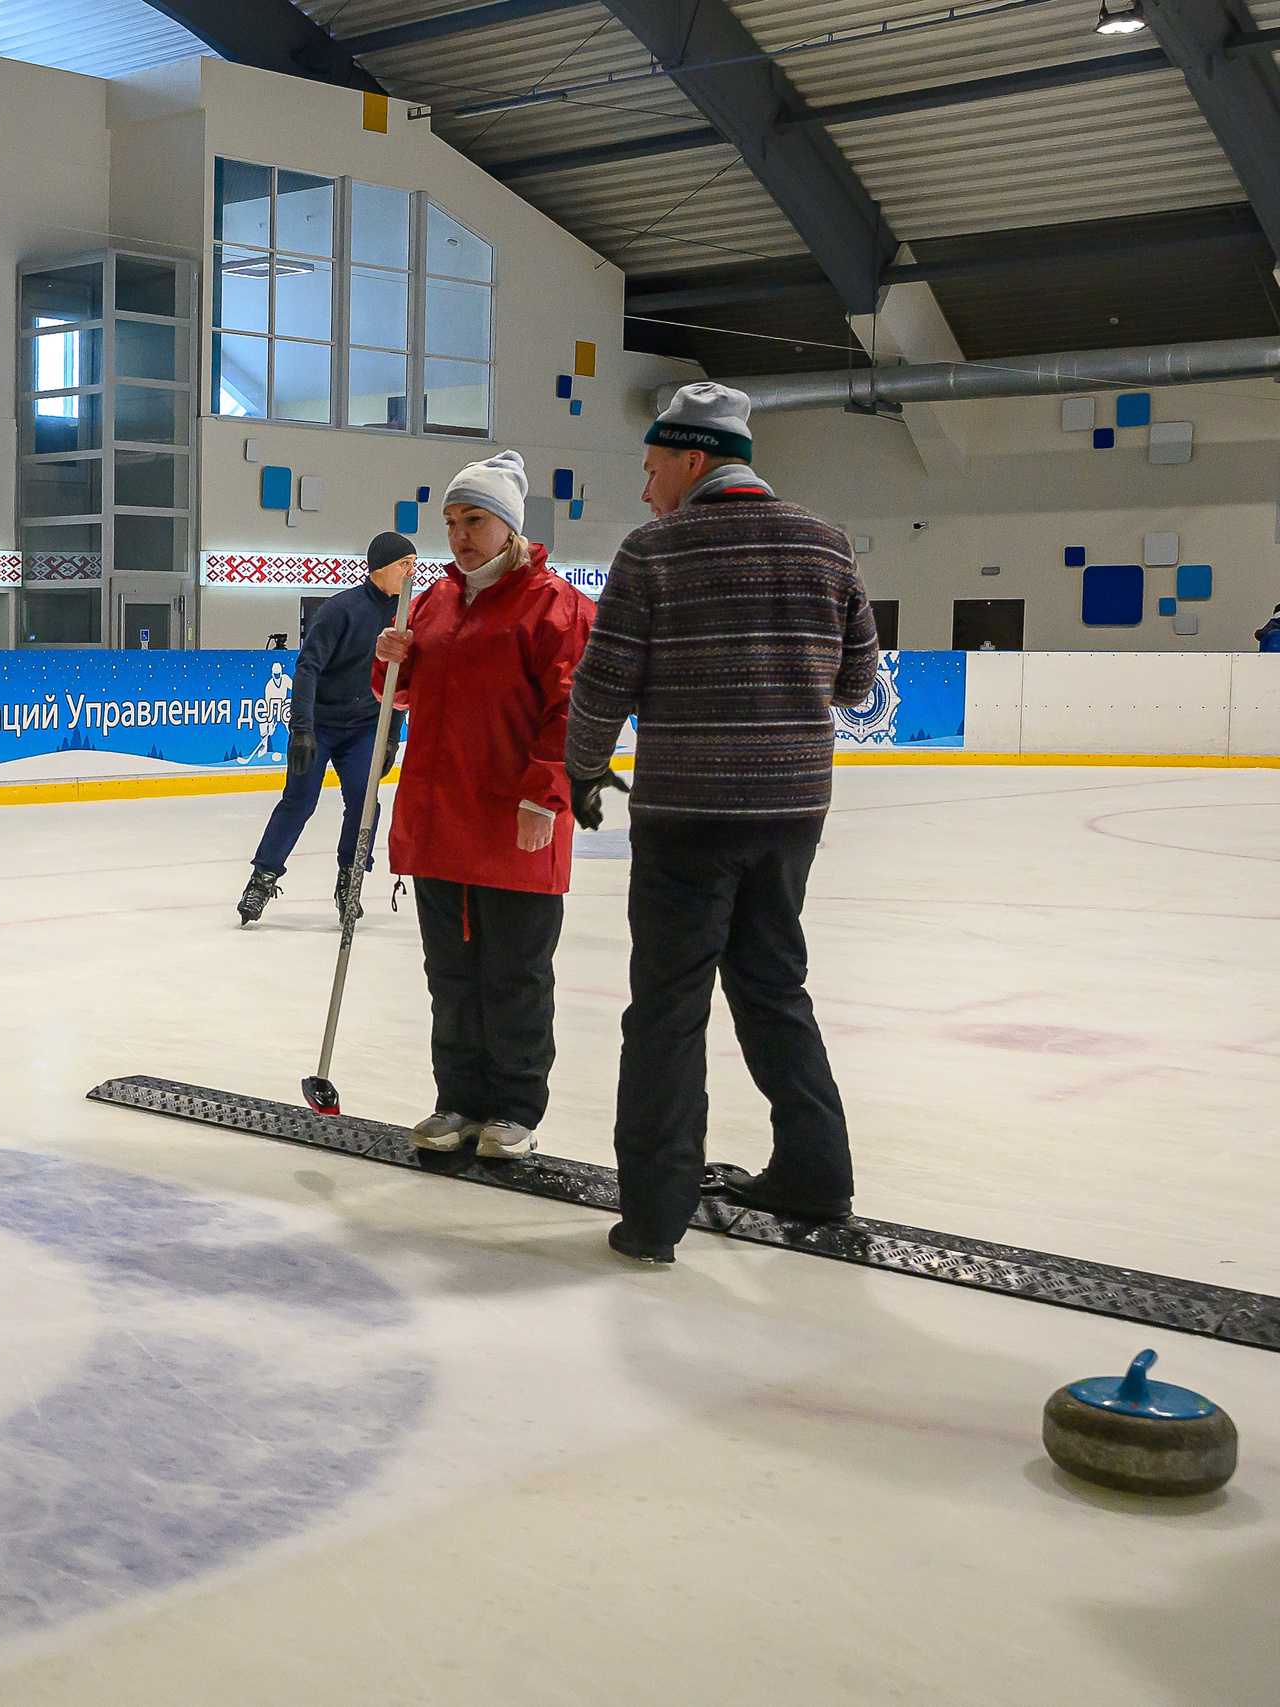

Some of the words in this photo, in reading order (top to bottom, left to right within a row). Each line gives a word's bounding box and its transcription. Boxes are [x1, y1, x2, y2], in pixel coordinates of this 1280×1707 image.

[659, 429, 719, 446] БЕЛАРУСЬ
[65, 693, 231, 737] Управления
[237, 698, 291, 730] дела
